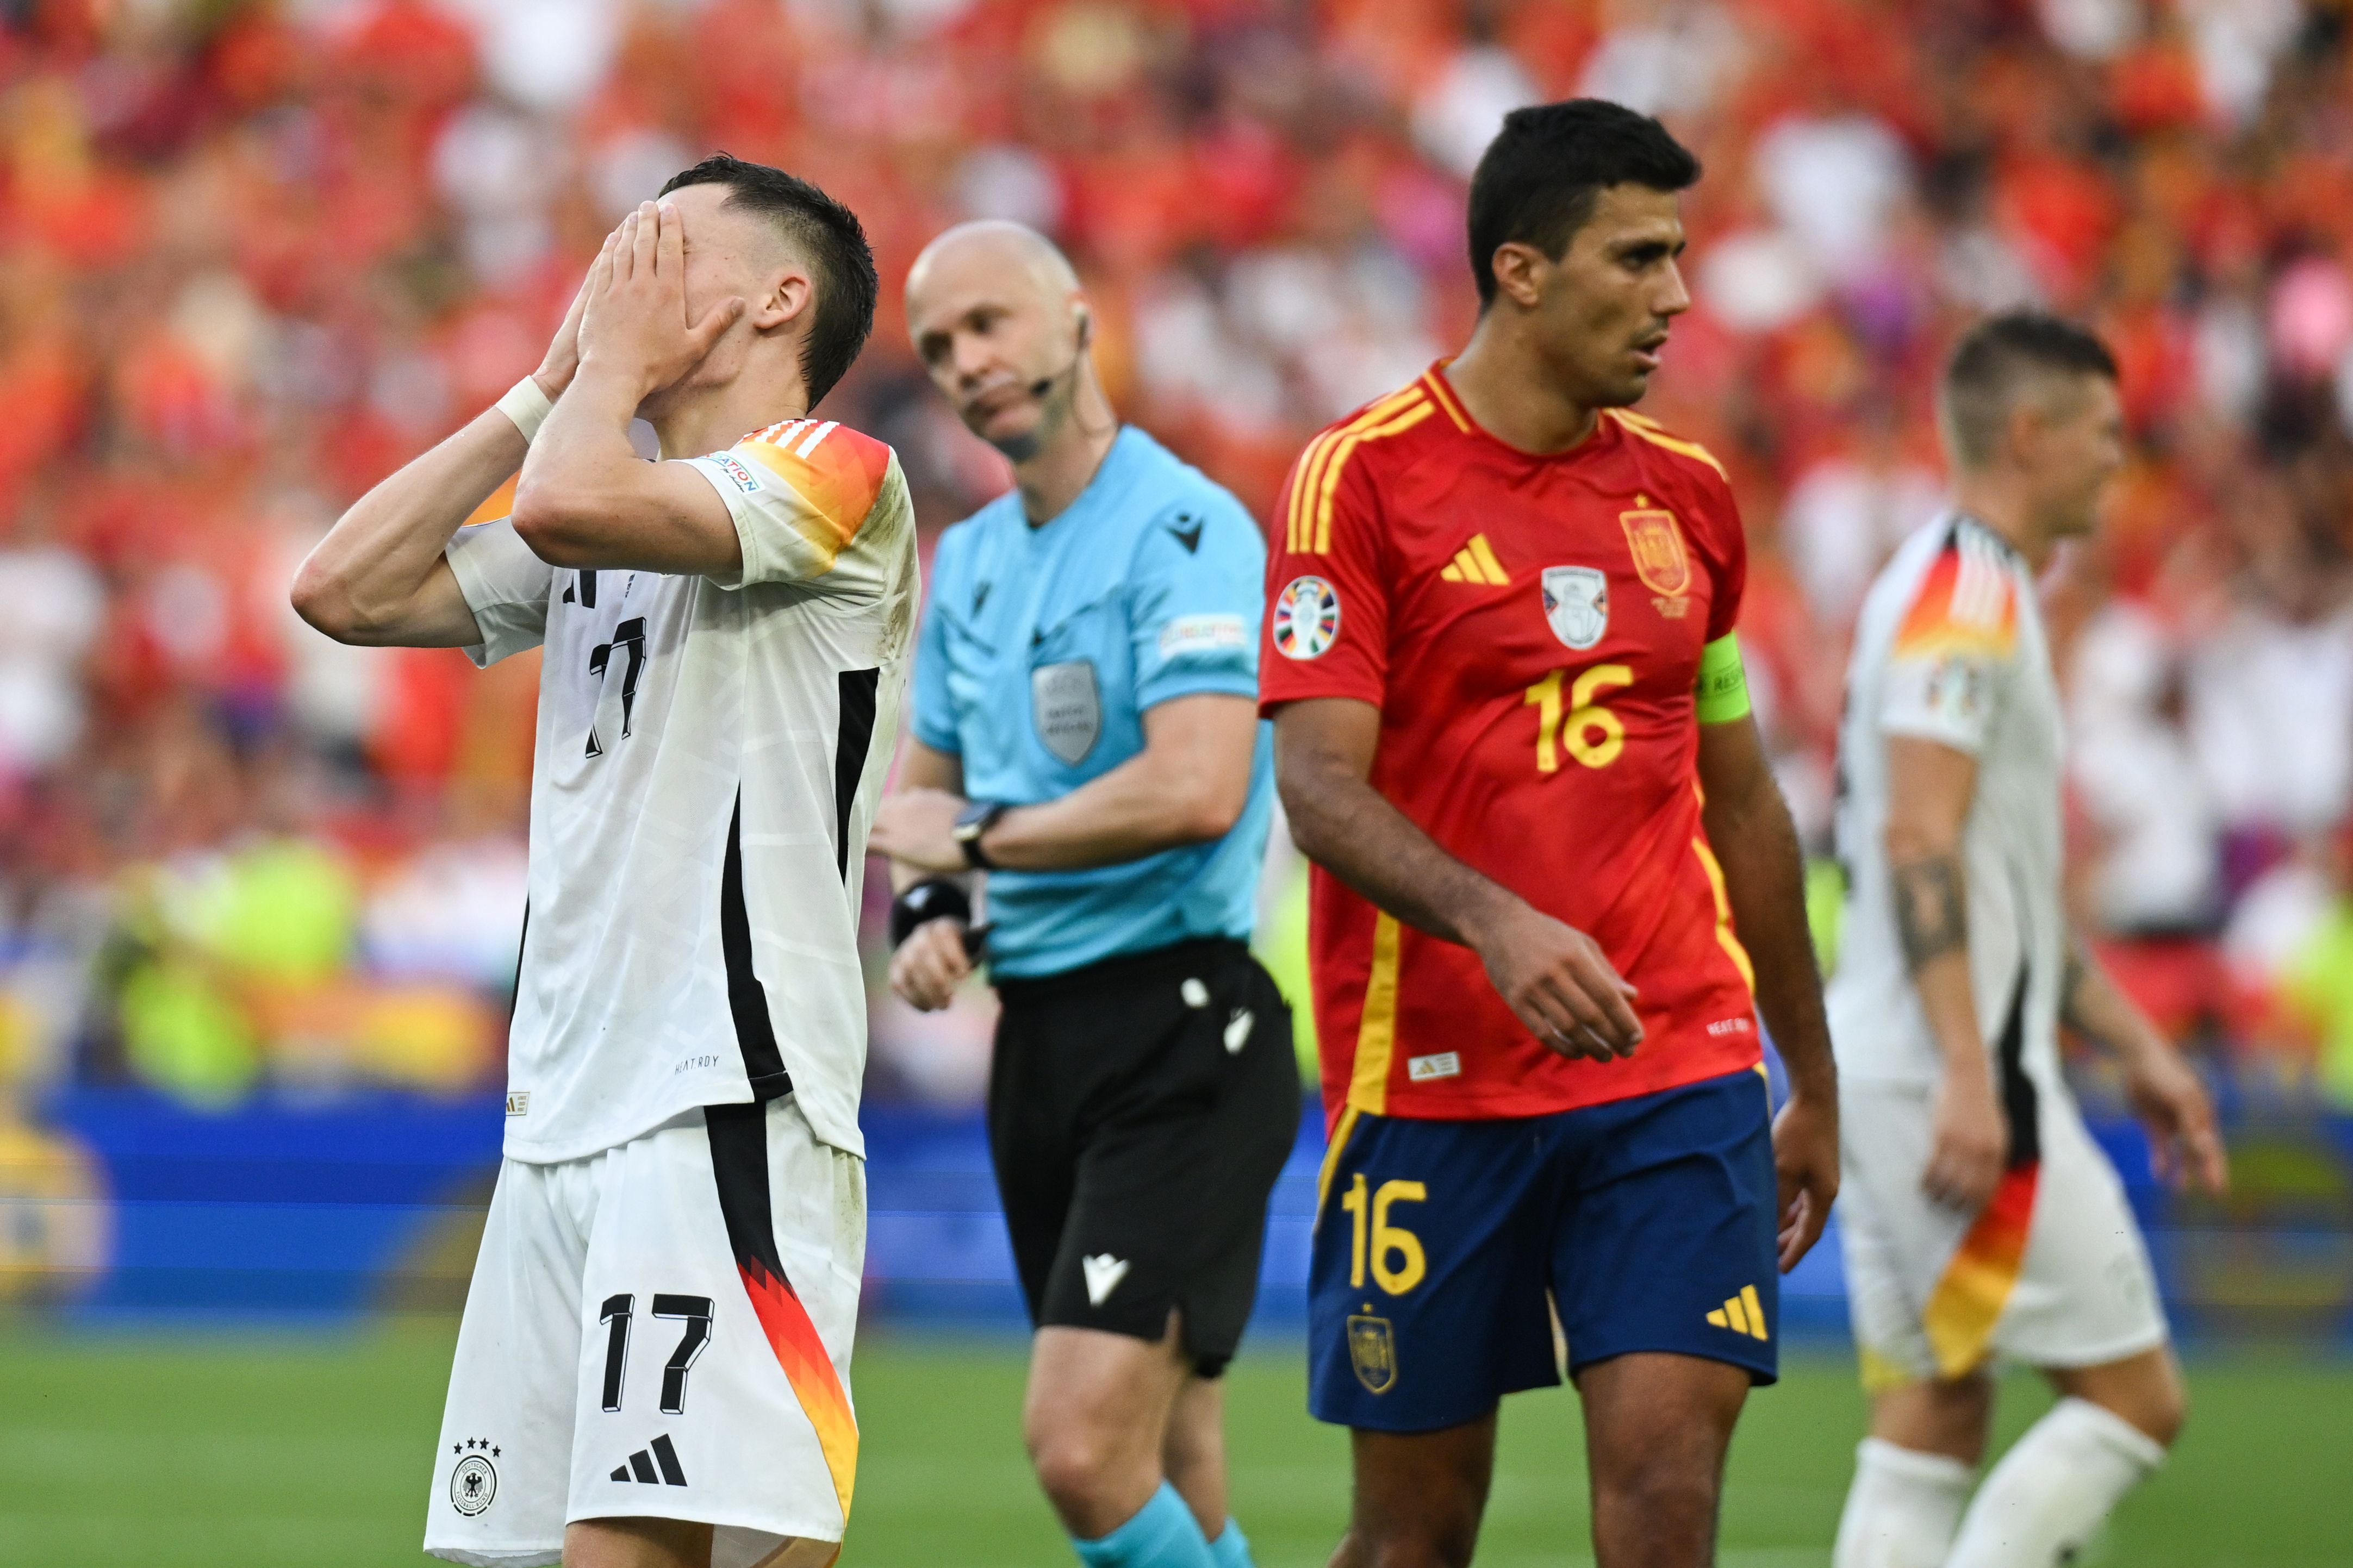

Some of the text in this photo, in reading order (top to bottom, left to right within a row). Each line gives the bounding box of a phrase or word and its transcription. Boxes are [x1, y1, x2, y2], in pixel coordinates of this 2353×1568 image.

[586, 617, 646, 759] 17
[1524, 664, 1633, 772] 16
[1342, 1172, 1427, 1296] 16
[600, 1294, 715, 1414] 17
[462, 1463, 487, 1474] DEUTSCHER
